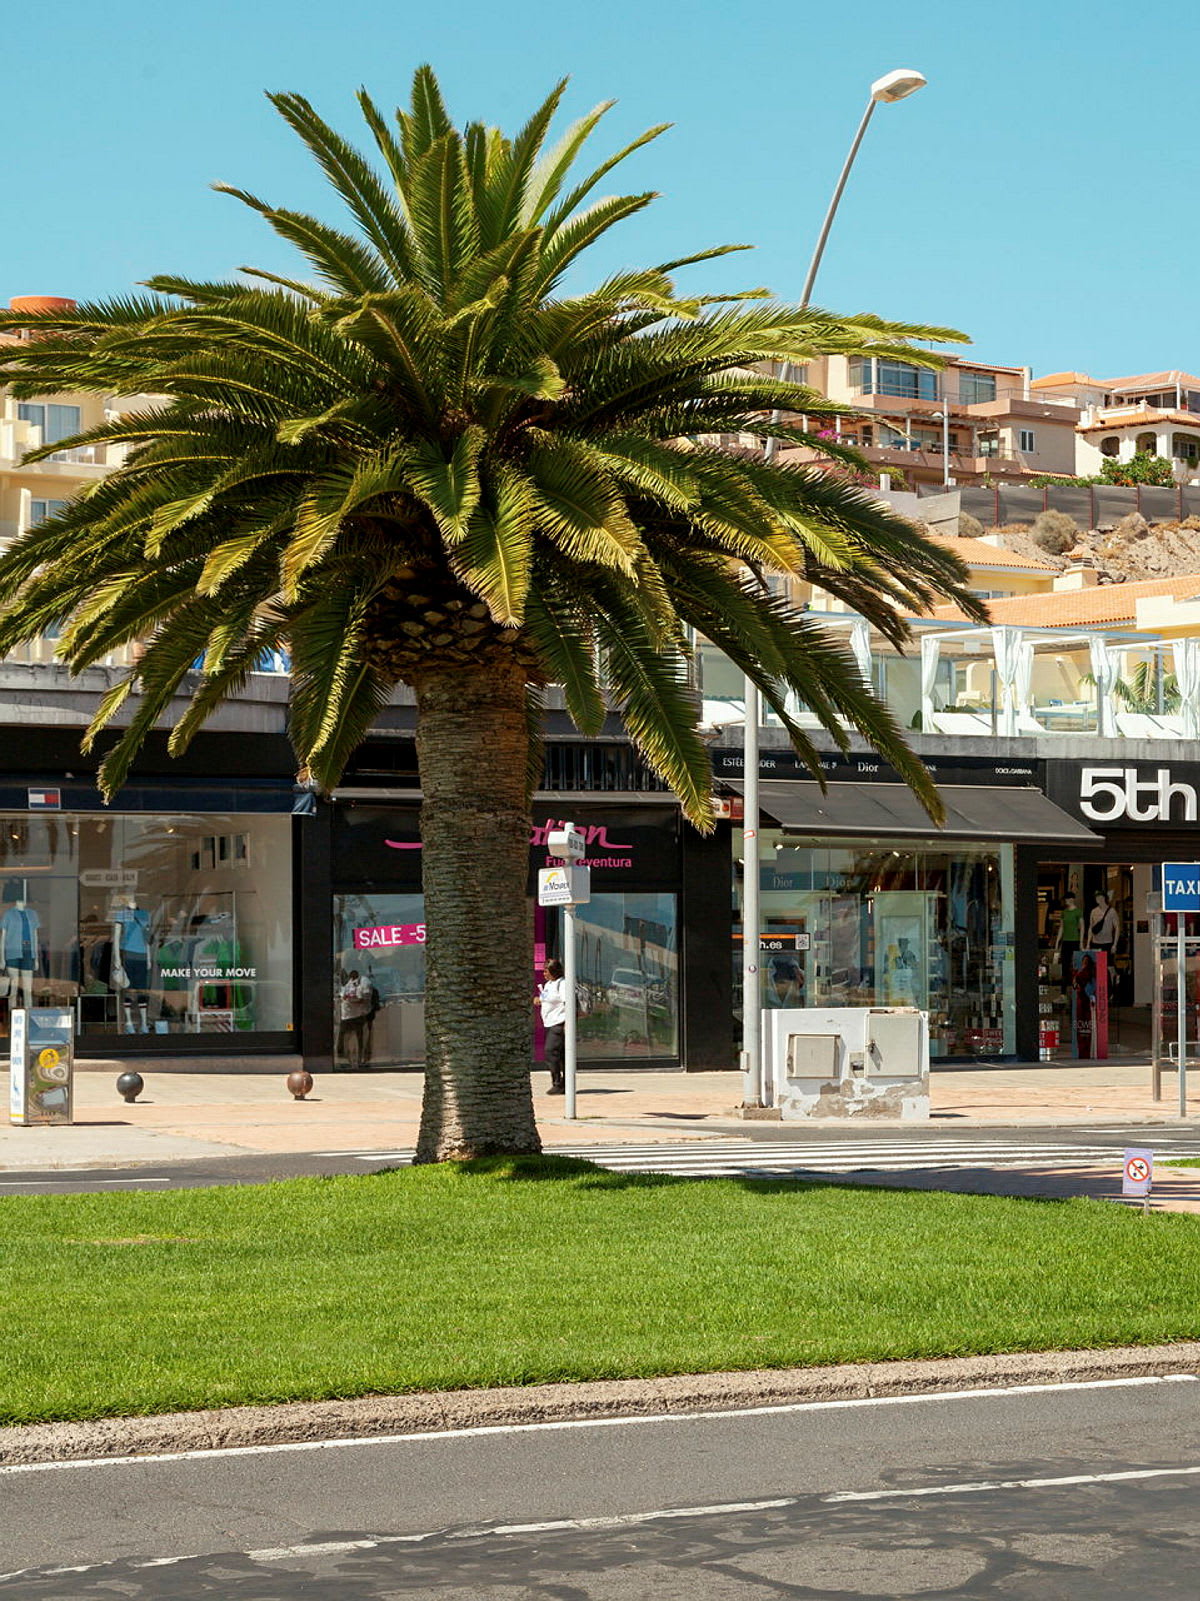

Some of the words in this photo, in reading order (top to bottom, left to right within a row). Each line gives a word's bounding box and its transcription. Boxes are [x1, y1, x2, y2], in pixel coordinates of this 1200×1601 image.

[857, 761, 879, 773] Dior
[1079, 767, 1198, 822] 5th
[545, 855, 633, 868] Fueeventura
[773, 876, 793, 888] Dior
[359, 927, 403, 947] SALE
[160, 968, 191, 977] MAKE
[193, 968, 223, 977] YOUR
[225, 968, 257, 977] MOVE
